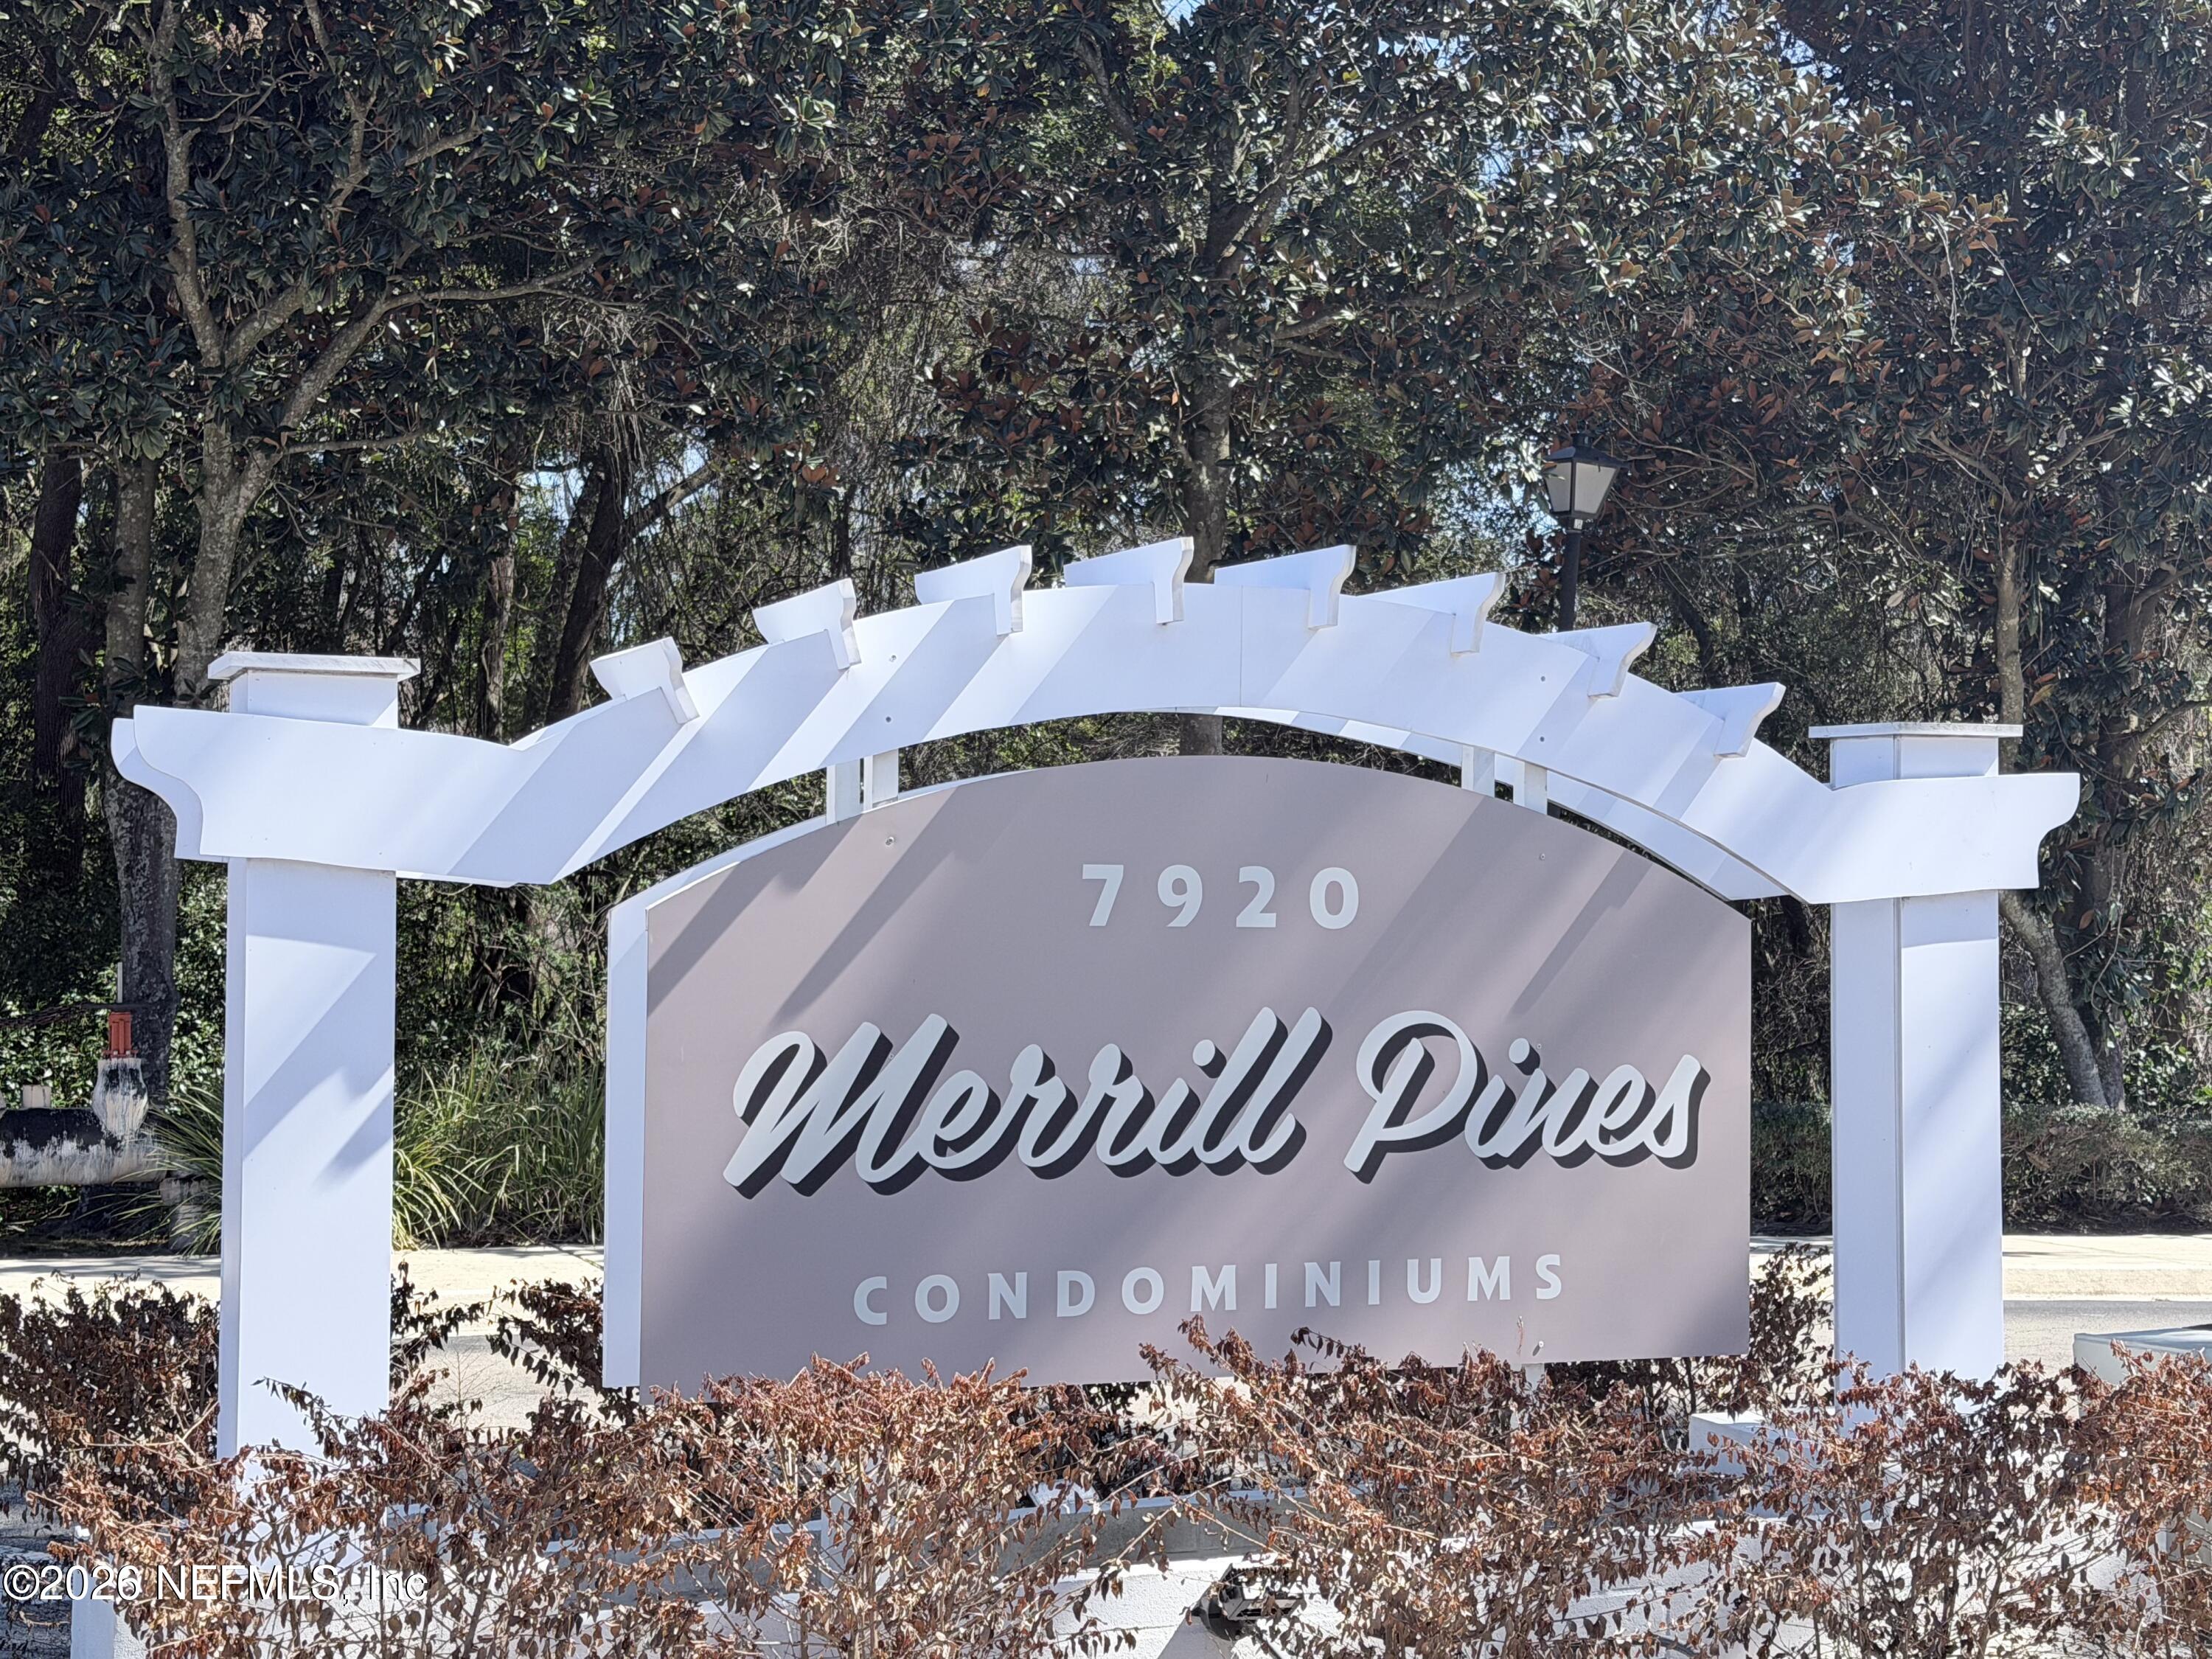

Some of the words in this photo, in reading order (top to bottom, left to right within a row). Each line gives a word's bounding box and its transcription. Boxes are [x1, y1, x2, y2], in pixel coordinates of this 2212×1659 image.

[1082, 863, 1360, 930] 7920
[723, 1006, 1333, 1200] Merrill
[1343, 1010, 1711, 1184] Pines
[853, 1253, 1562, 1326] CONDOMINIUMS
